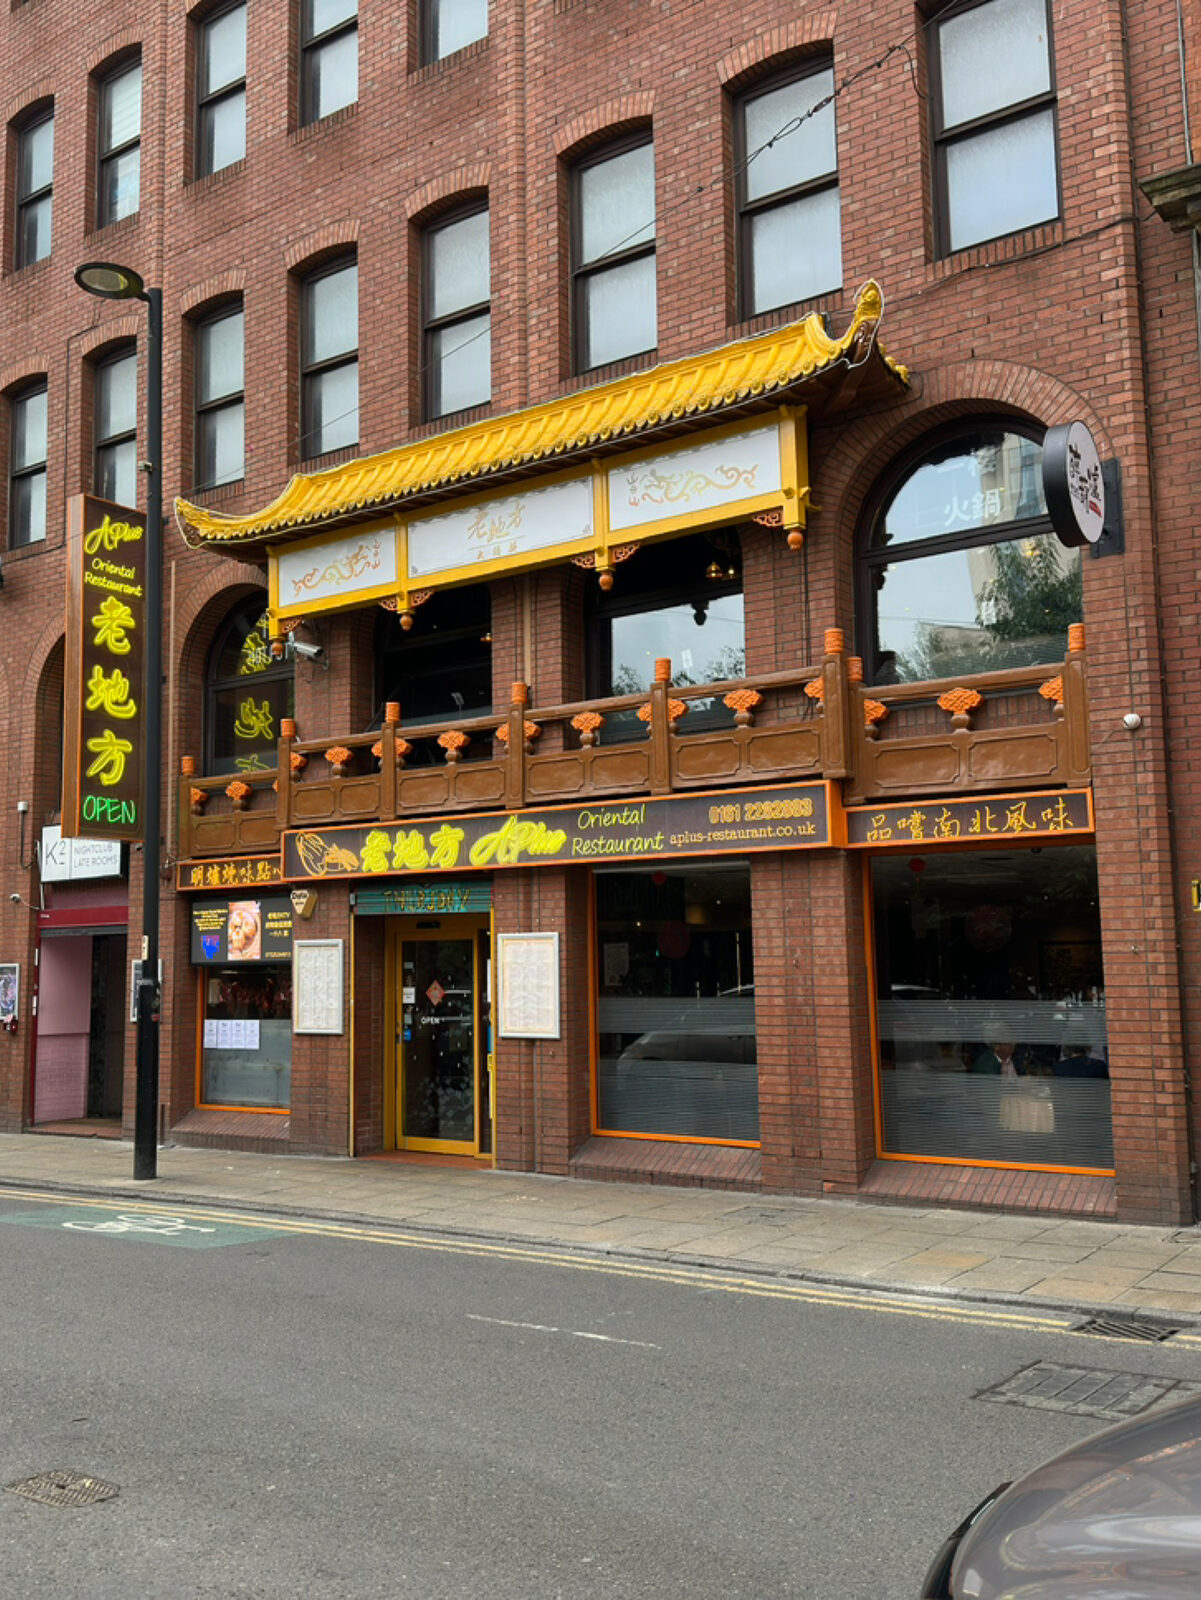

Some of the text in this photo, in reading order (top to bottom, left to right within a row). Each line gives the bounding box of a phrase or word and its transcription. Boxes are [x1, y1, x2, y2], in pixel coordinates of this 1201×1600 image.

[944, 488, 1000, 526] 火鍋
[92, 558, 135, 579] Oriental
[85, 571, 142, 597] Restaurant
[86, 595, 137, 786] 老地方
[83, 795, 136, 824] OPEN
[577, 803, 646, 830] Oriental
[709, 804, 740, 824] 0161
[571, 832, 665, 856] Restaurant
[669, 822, 816, 846] aplus-restaurant.co.uk
[73, 842, 113, 856] NIGHTCLUB
[360, 823, 465, 872] 老地方
[73, 854, 118, 869] LATE ROOMS
